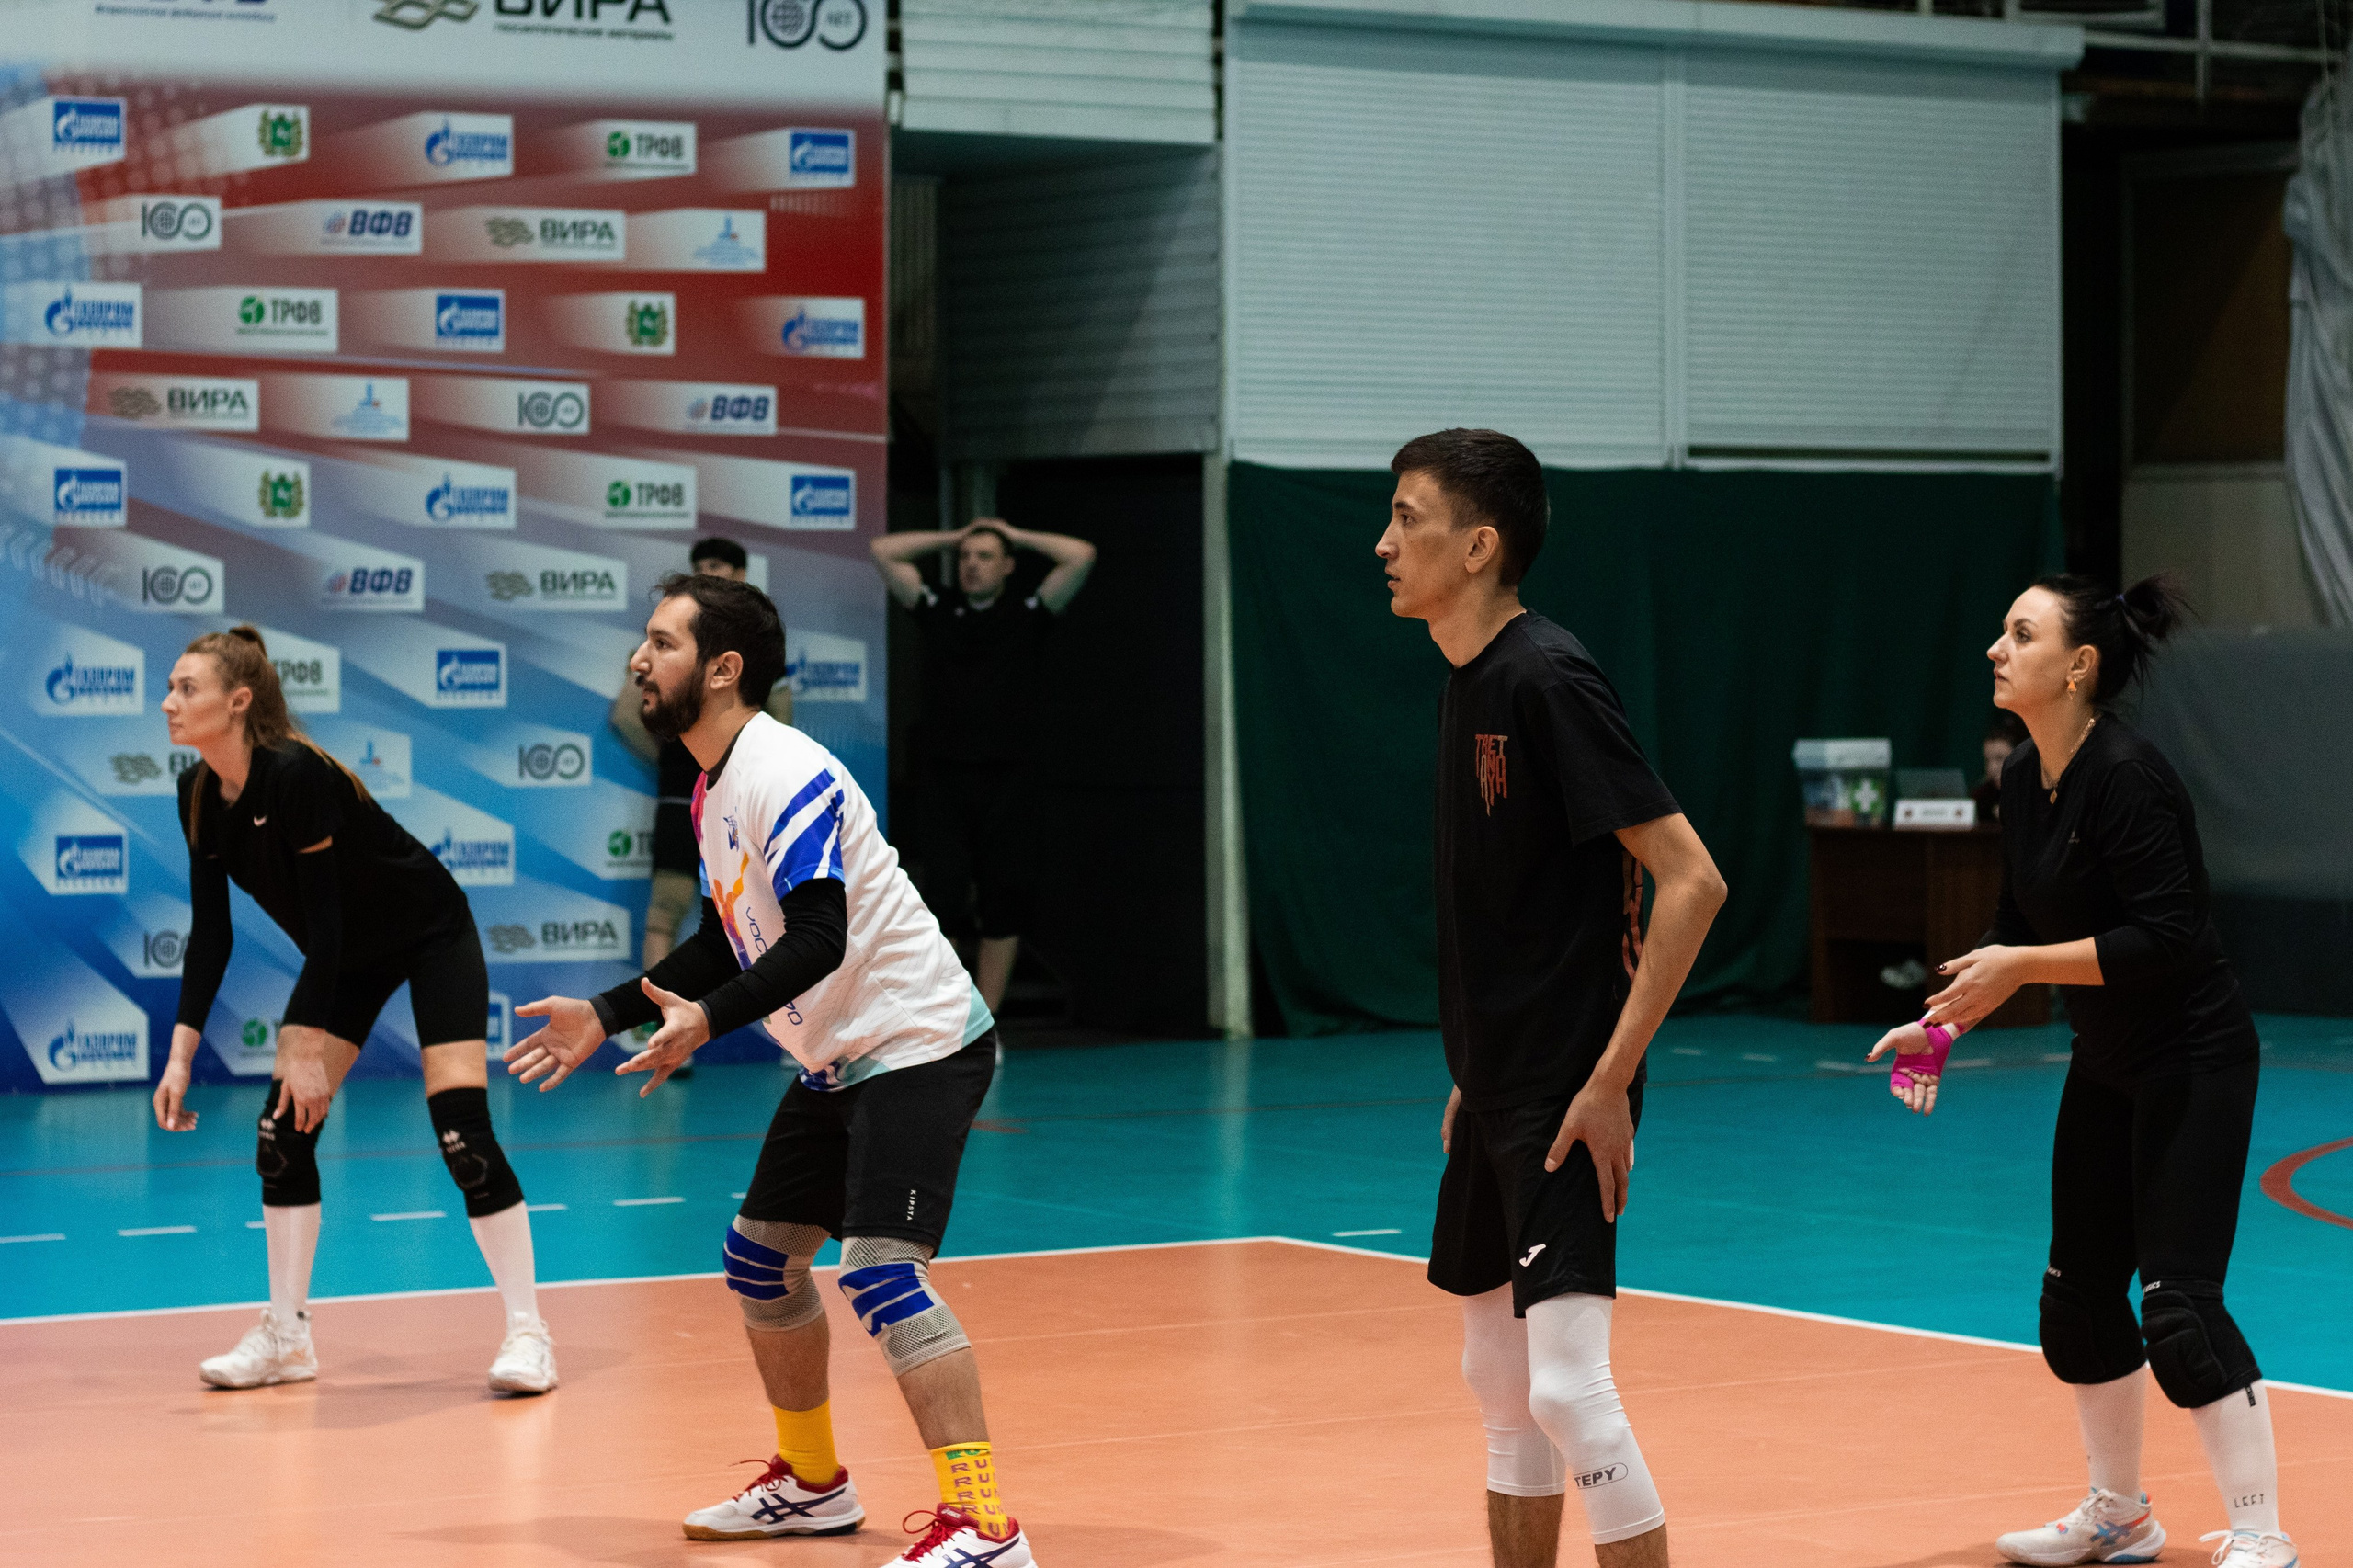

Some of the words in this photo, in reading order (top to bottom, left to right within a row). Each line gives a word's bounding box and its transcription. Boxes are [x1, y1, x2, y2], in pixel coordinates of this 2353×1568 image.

[348, 210, 413, 237] ВФВ
[540, 218, 616, 241] ВИРА
[166, 387, 248, 411] ВИРА
[710, 395, 770, 422] ВФВ
[347, 567, 413, 595] ВФВ
[540, 570, 616, 593] ВИРА
[540, 921, 619, 944] ВИРА
[906, 1189, 916, 1221] KIPSTA
